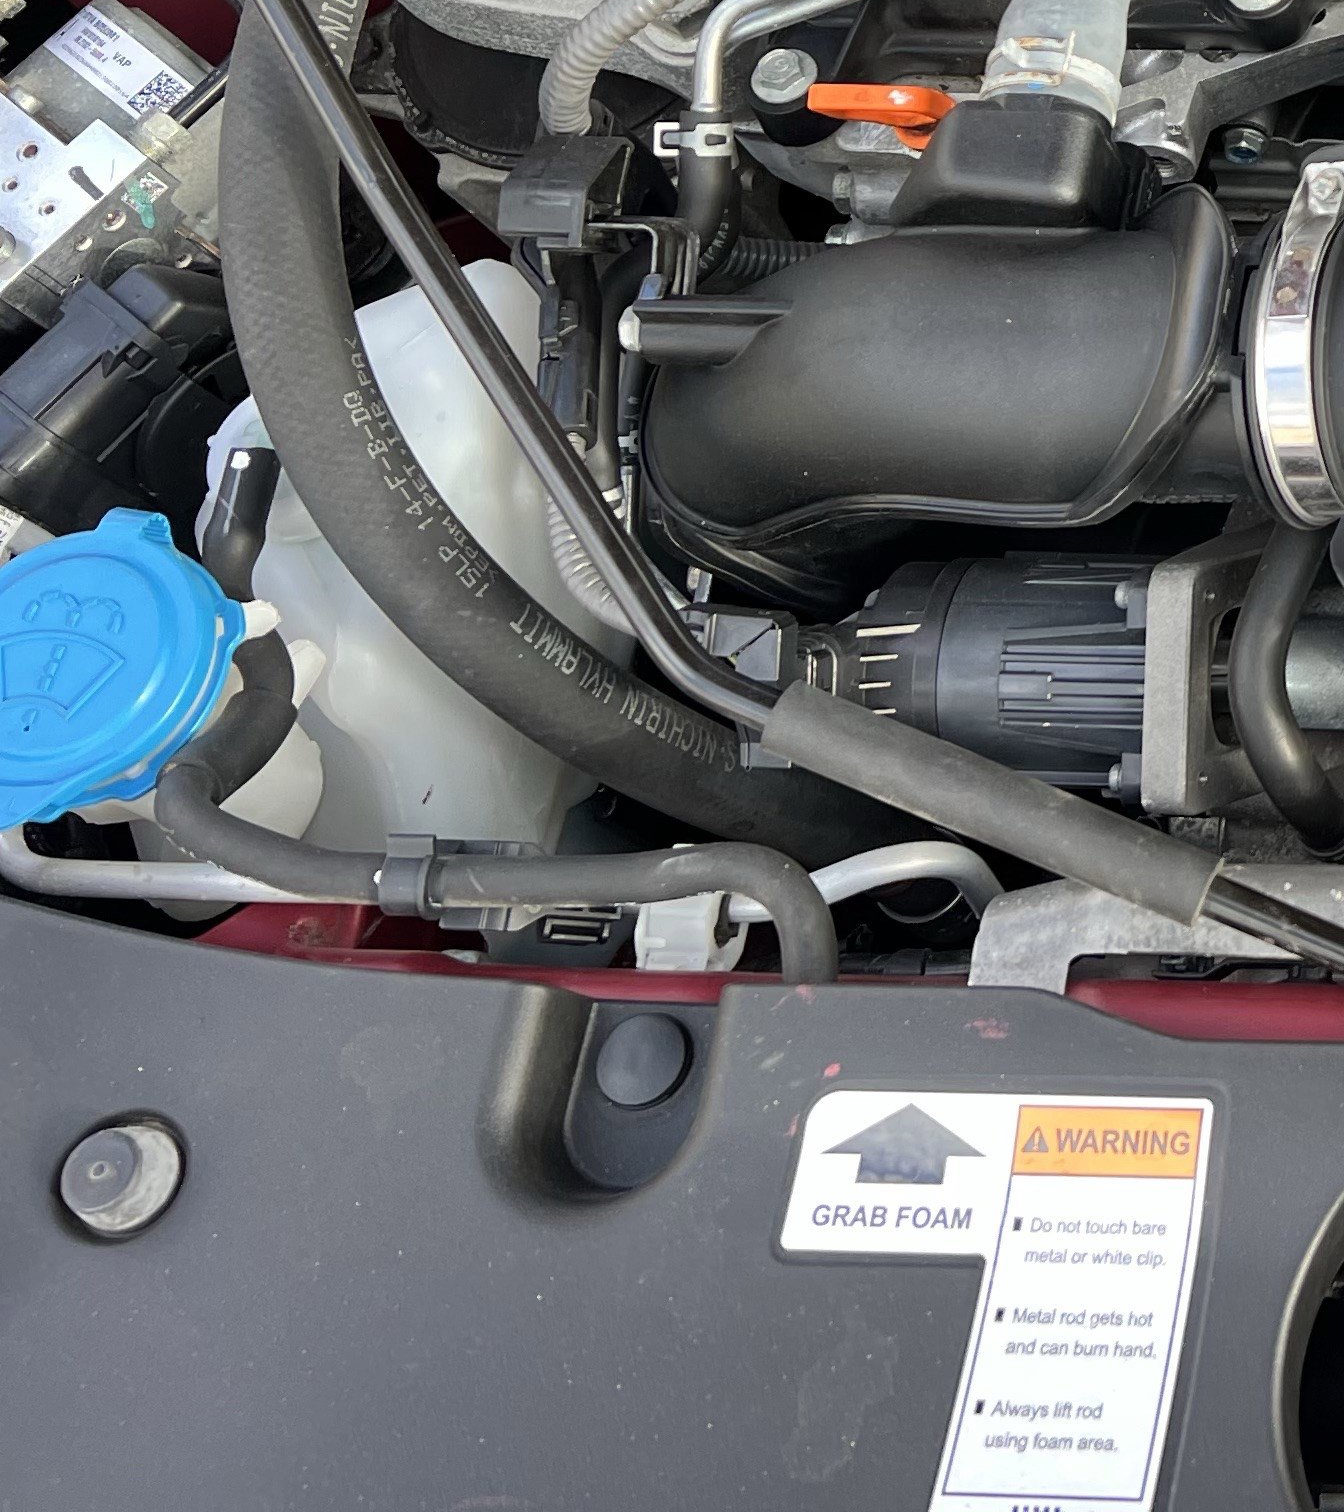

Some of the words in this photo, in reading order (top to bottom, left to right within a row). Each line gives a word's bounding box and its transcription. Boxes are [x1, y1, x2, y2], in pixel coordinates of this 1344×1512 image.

[112, 51, 132, 67] VAP
[1056, 1128, 1191, 1156] WARNING
[812, 1204, 888, 1227] GRAB
[895, 1206, 973, 1229] FOAM
[1030, 1218, 1052, 1234] Do
[1057, 1218, 1081, 1234] not
[1085, 1219, 1128, 1235] touch
[1132, 1220, 1166, 1236] bare
[1024, 1248, 1068, 1264] metal
[1071, 1253, 1088, 1264] or
[1092, 1250, 1132, 1266] white
[1136, 1251, 1167, 1269] clip.
[1012, 1308, 1057, 1326] Metal
[1061, 1309, 1086, 1326] rod
[1089, 1312, 1125, 1330] gets
[1128, 1311, 1153, 1328] hot
[1005, 1340, 1035, 1355] and
[1039, 1343, 1069, 1356] can
[1074, 1341, 1108, 1358] burn
[991, 1401, 1050, 1420] Always
[1053, 1401, 1072, 1419] lift
[1076, 1403, 1103, 1420] rod
[984, 1433, 1028, 1453] using
[1033, 1433, 1073, 1451] foam
